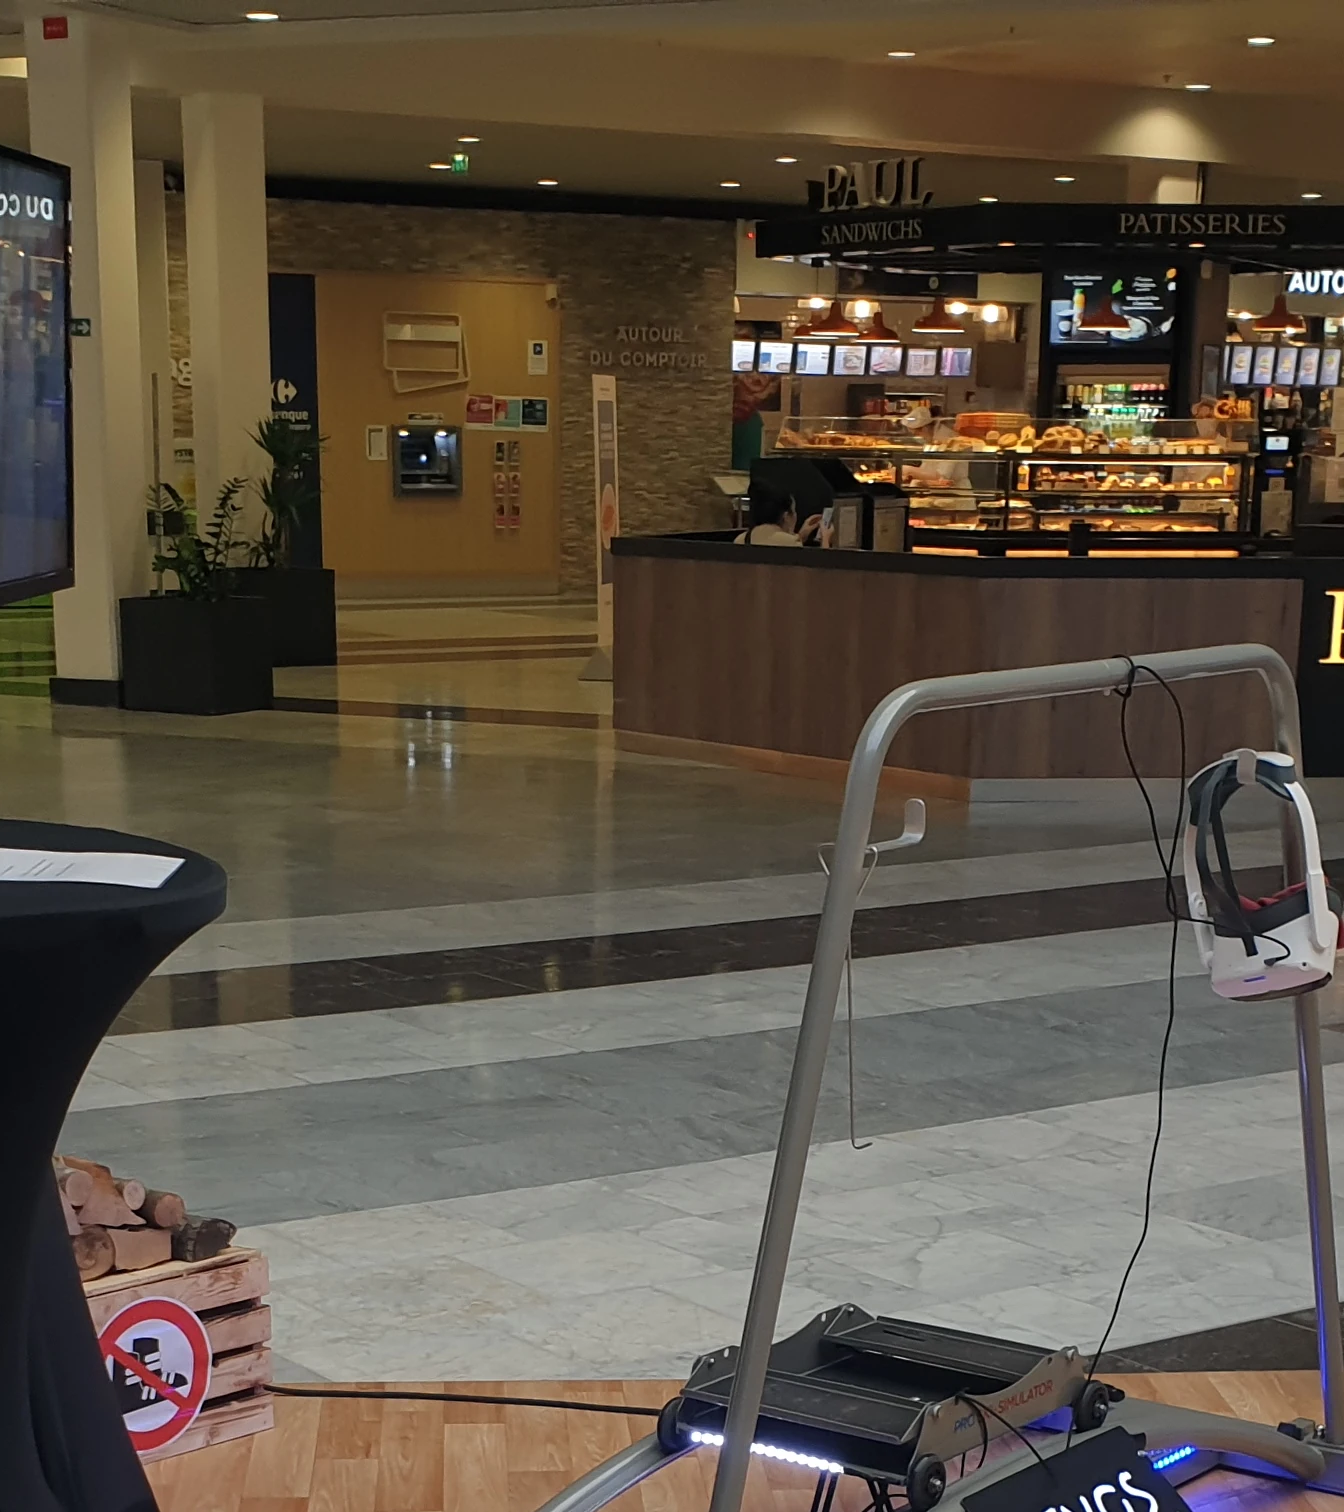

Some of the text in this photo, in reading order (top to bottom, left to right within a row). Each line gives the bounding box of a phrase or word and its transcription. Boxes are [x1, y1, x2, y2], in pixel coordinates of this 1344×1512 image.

[819, 155, 935, 213] PAUL
[820, 217, 924, 246] SANDWICHS
[1119, 212, 1287, 236] PATISSERIES
[617, 326, 684, 342] AUTOUR
[590, 350, 708, 367] DU COMPTOIR
